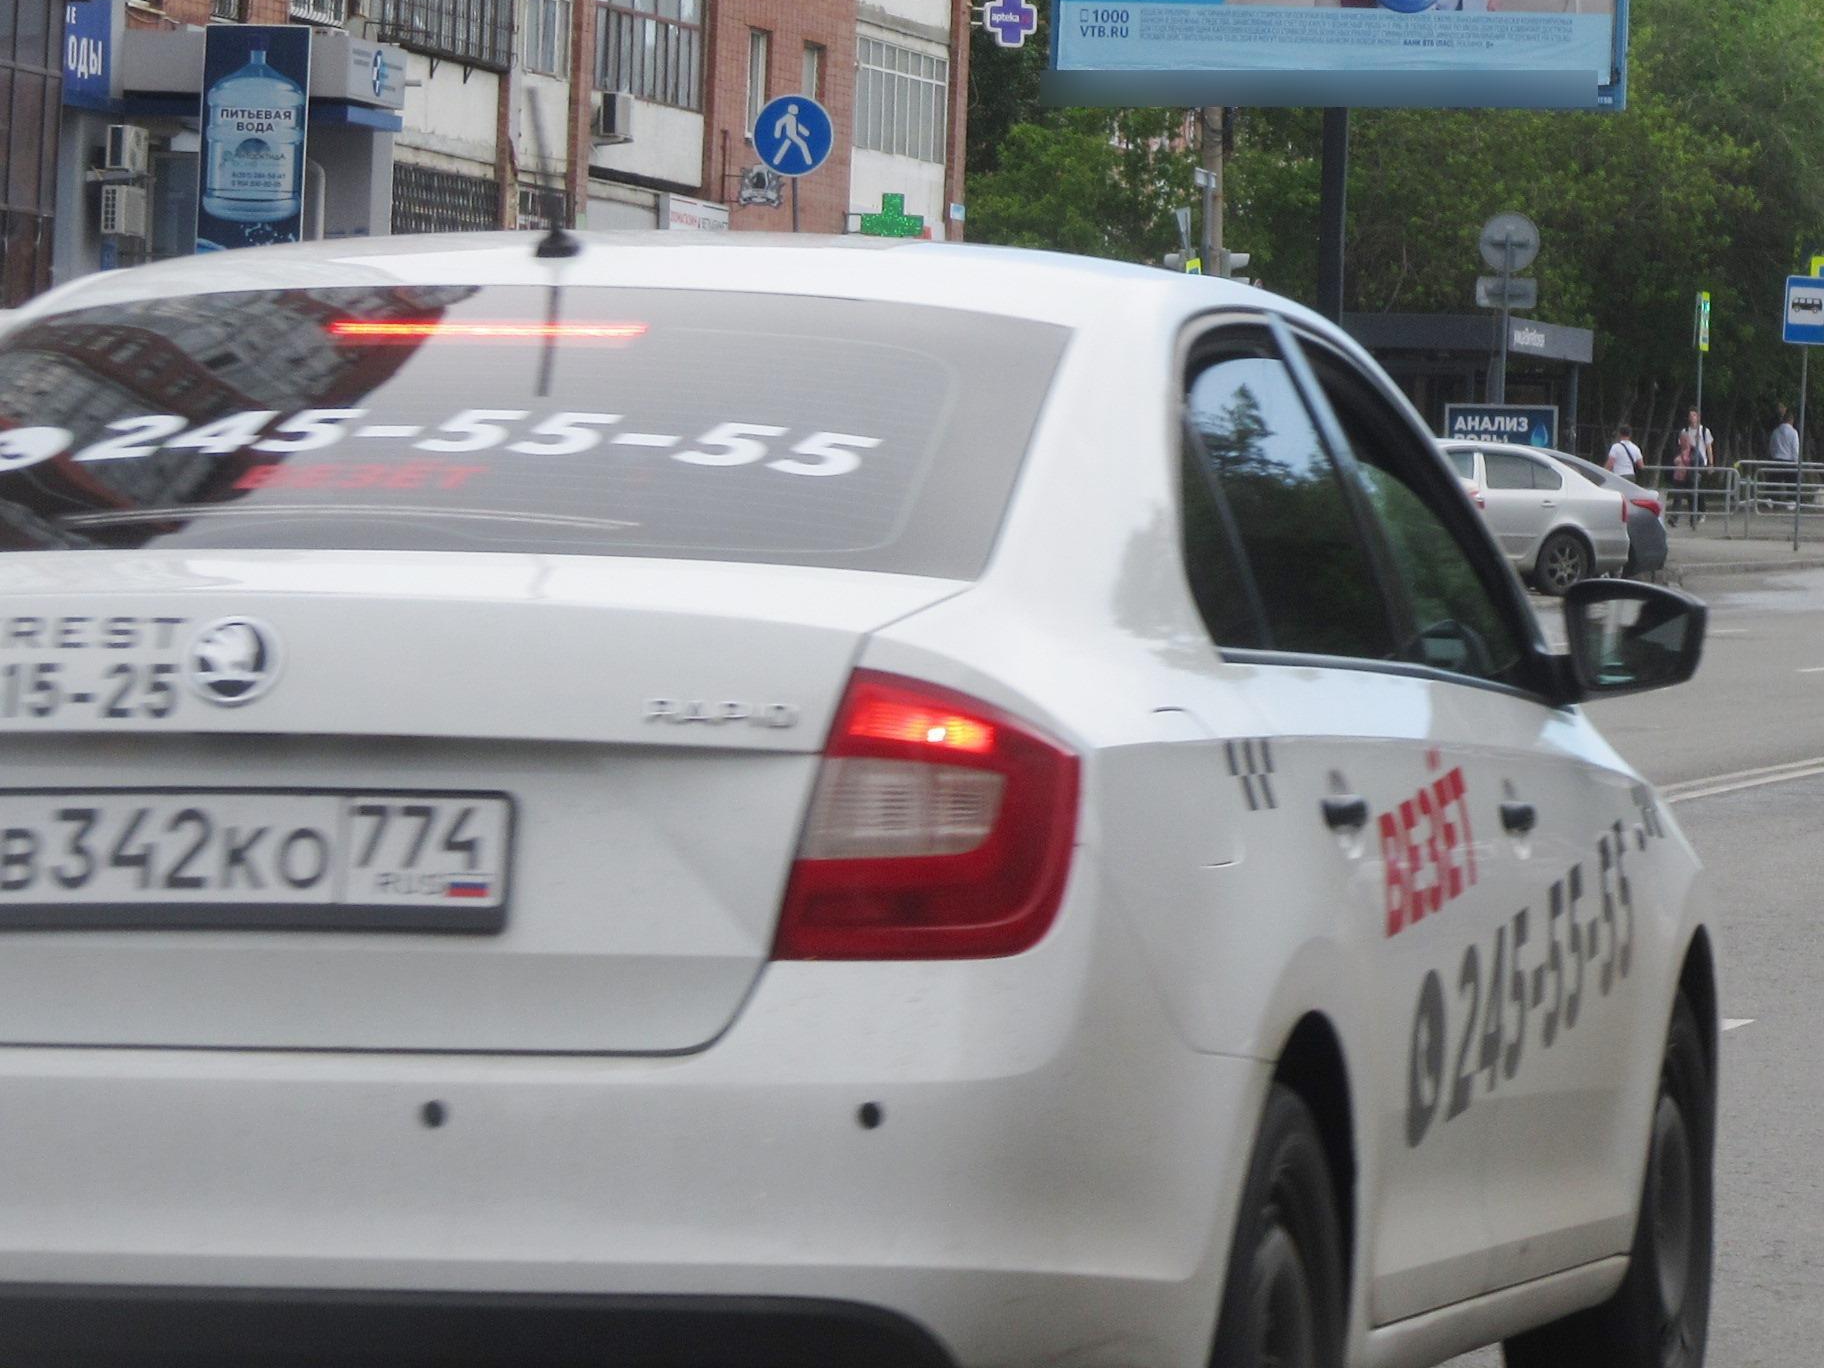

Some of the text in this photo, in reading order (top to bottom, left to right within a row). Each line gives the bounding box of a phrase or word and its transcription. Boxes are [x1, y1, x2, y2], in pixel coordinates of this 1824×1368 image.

[1092, 9, 1130, 24] 1000
[1079, 25, 1130, 38] VTB.RU
[220, 108, 293, 121] ПИТЬЕВАЯ
[236, 122, 274, 134] ВОДА
[1453, 415, 1529, 432] АНАЛИЗ
[72, 408, 885, 477] 245-55-55
[0, 803, 484, 892] В342КО 774
